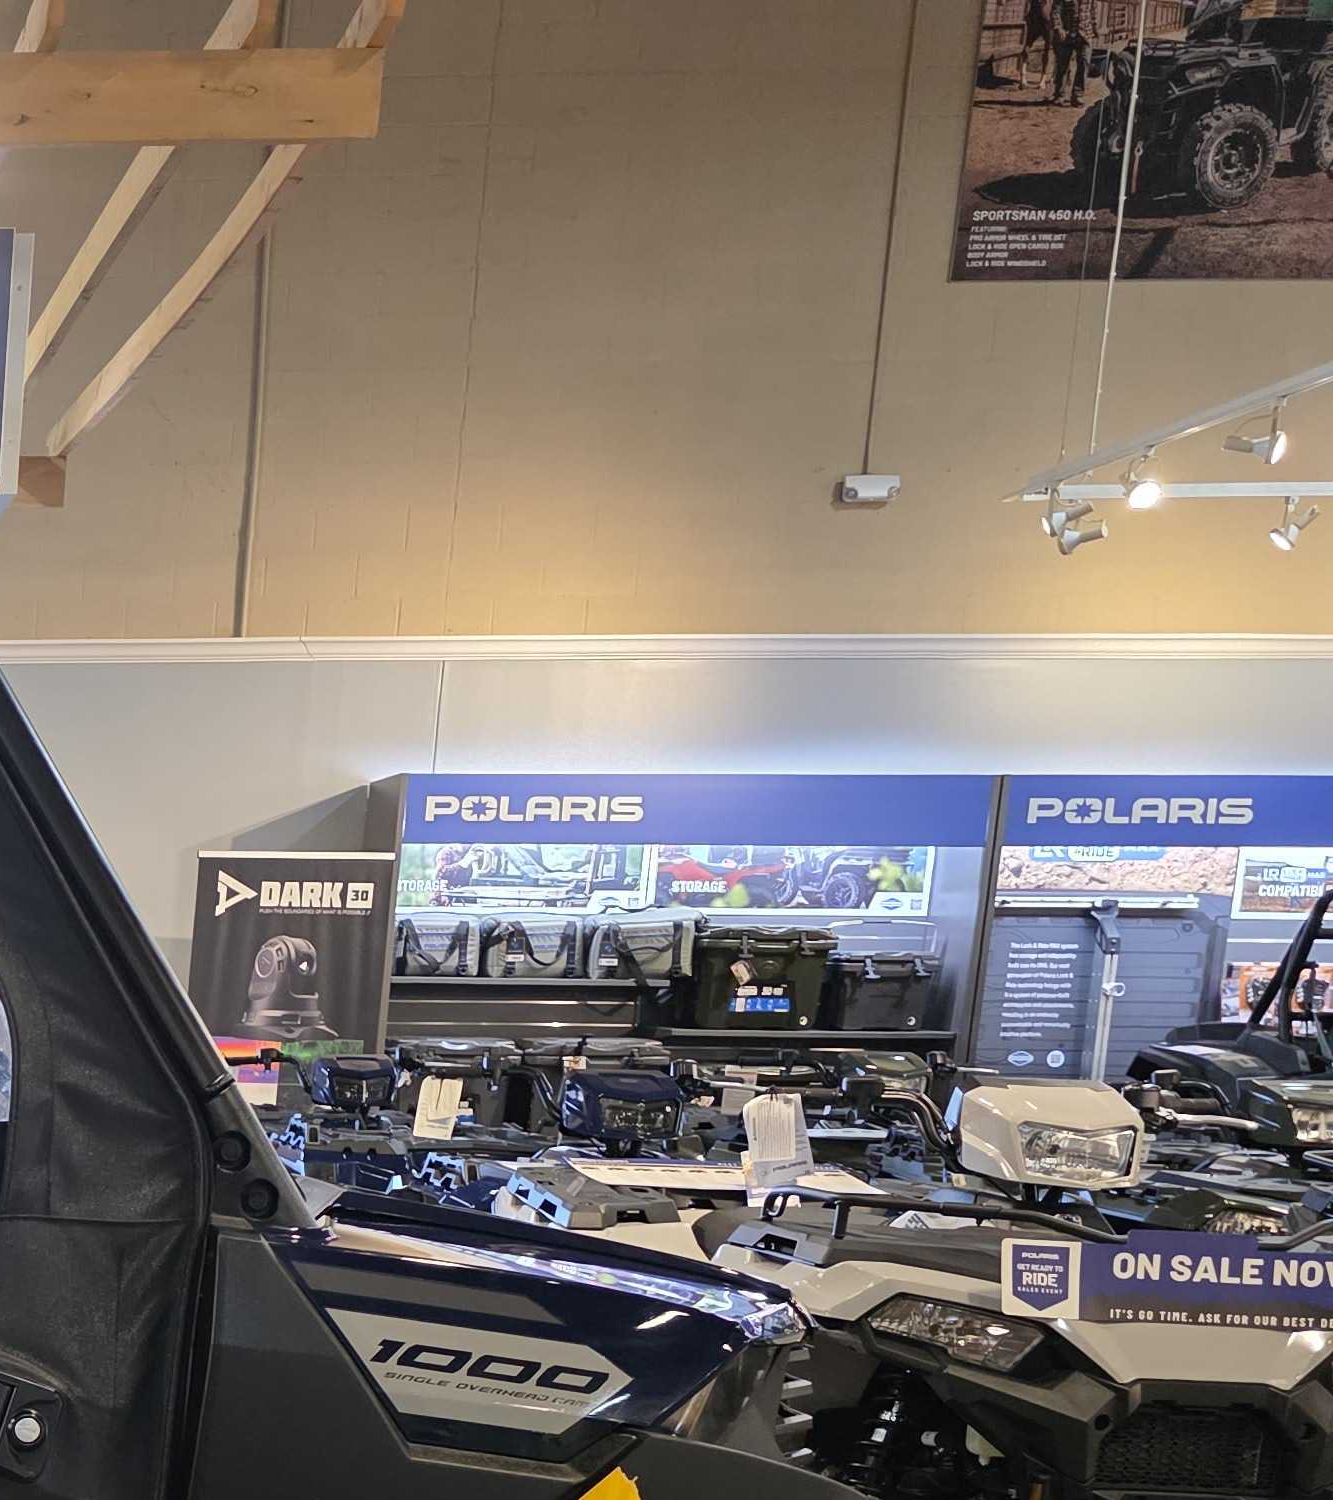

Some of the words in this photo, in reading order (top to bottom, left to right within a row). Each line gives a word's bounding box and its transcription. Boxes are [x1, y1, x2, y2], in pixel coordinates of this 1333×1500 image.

[972, 209, 1046, 222] SPORTSMAN
[424, 795, 645, 823] POLARIS
[1026, 797, 1254, 825] POLARIS
[259, 881, 344, 908] DARK
[671, 880, 727, 894] STORAGE
[1022, 1271, 1059, 1287] RIDE
[1112, 1252, 1162, 1281] ON
[1170, 1253, 1265, 1285] SALE
[1109, 1308, 1134, 1320] IT'S
[1138, 1309, 1154, 1321] GO
[1159, 1310, 1193, 1323] TIME.
[1198, 1311, 1222, 1324] ASK
[1226, 1313, 1249, 1325] FOR
[1253, 1315, 1278, 1327] OUR
[1282, 1316, 1315, 1328] BEST
[369, 1338, 610, 1395] 1000
[383, 1371, 451, 1388] SINGLE
[455, 1382, 551, 1403] OVERHEAD
